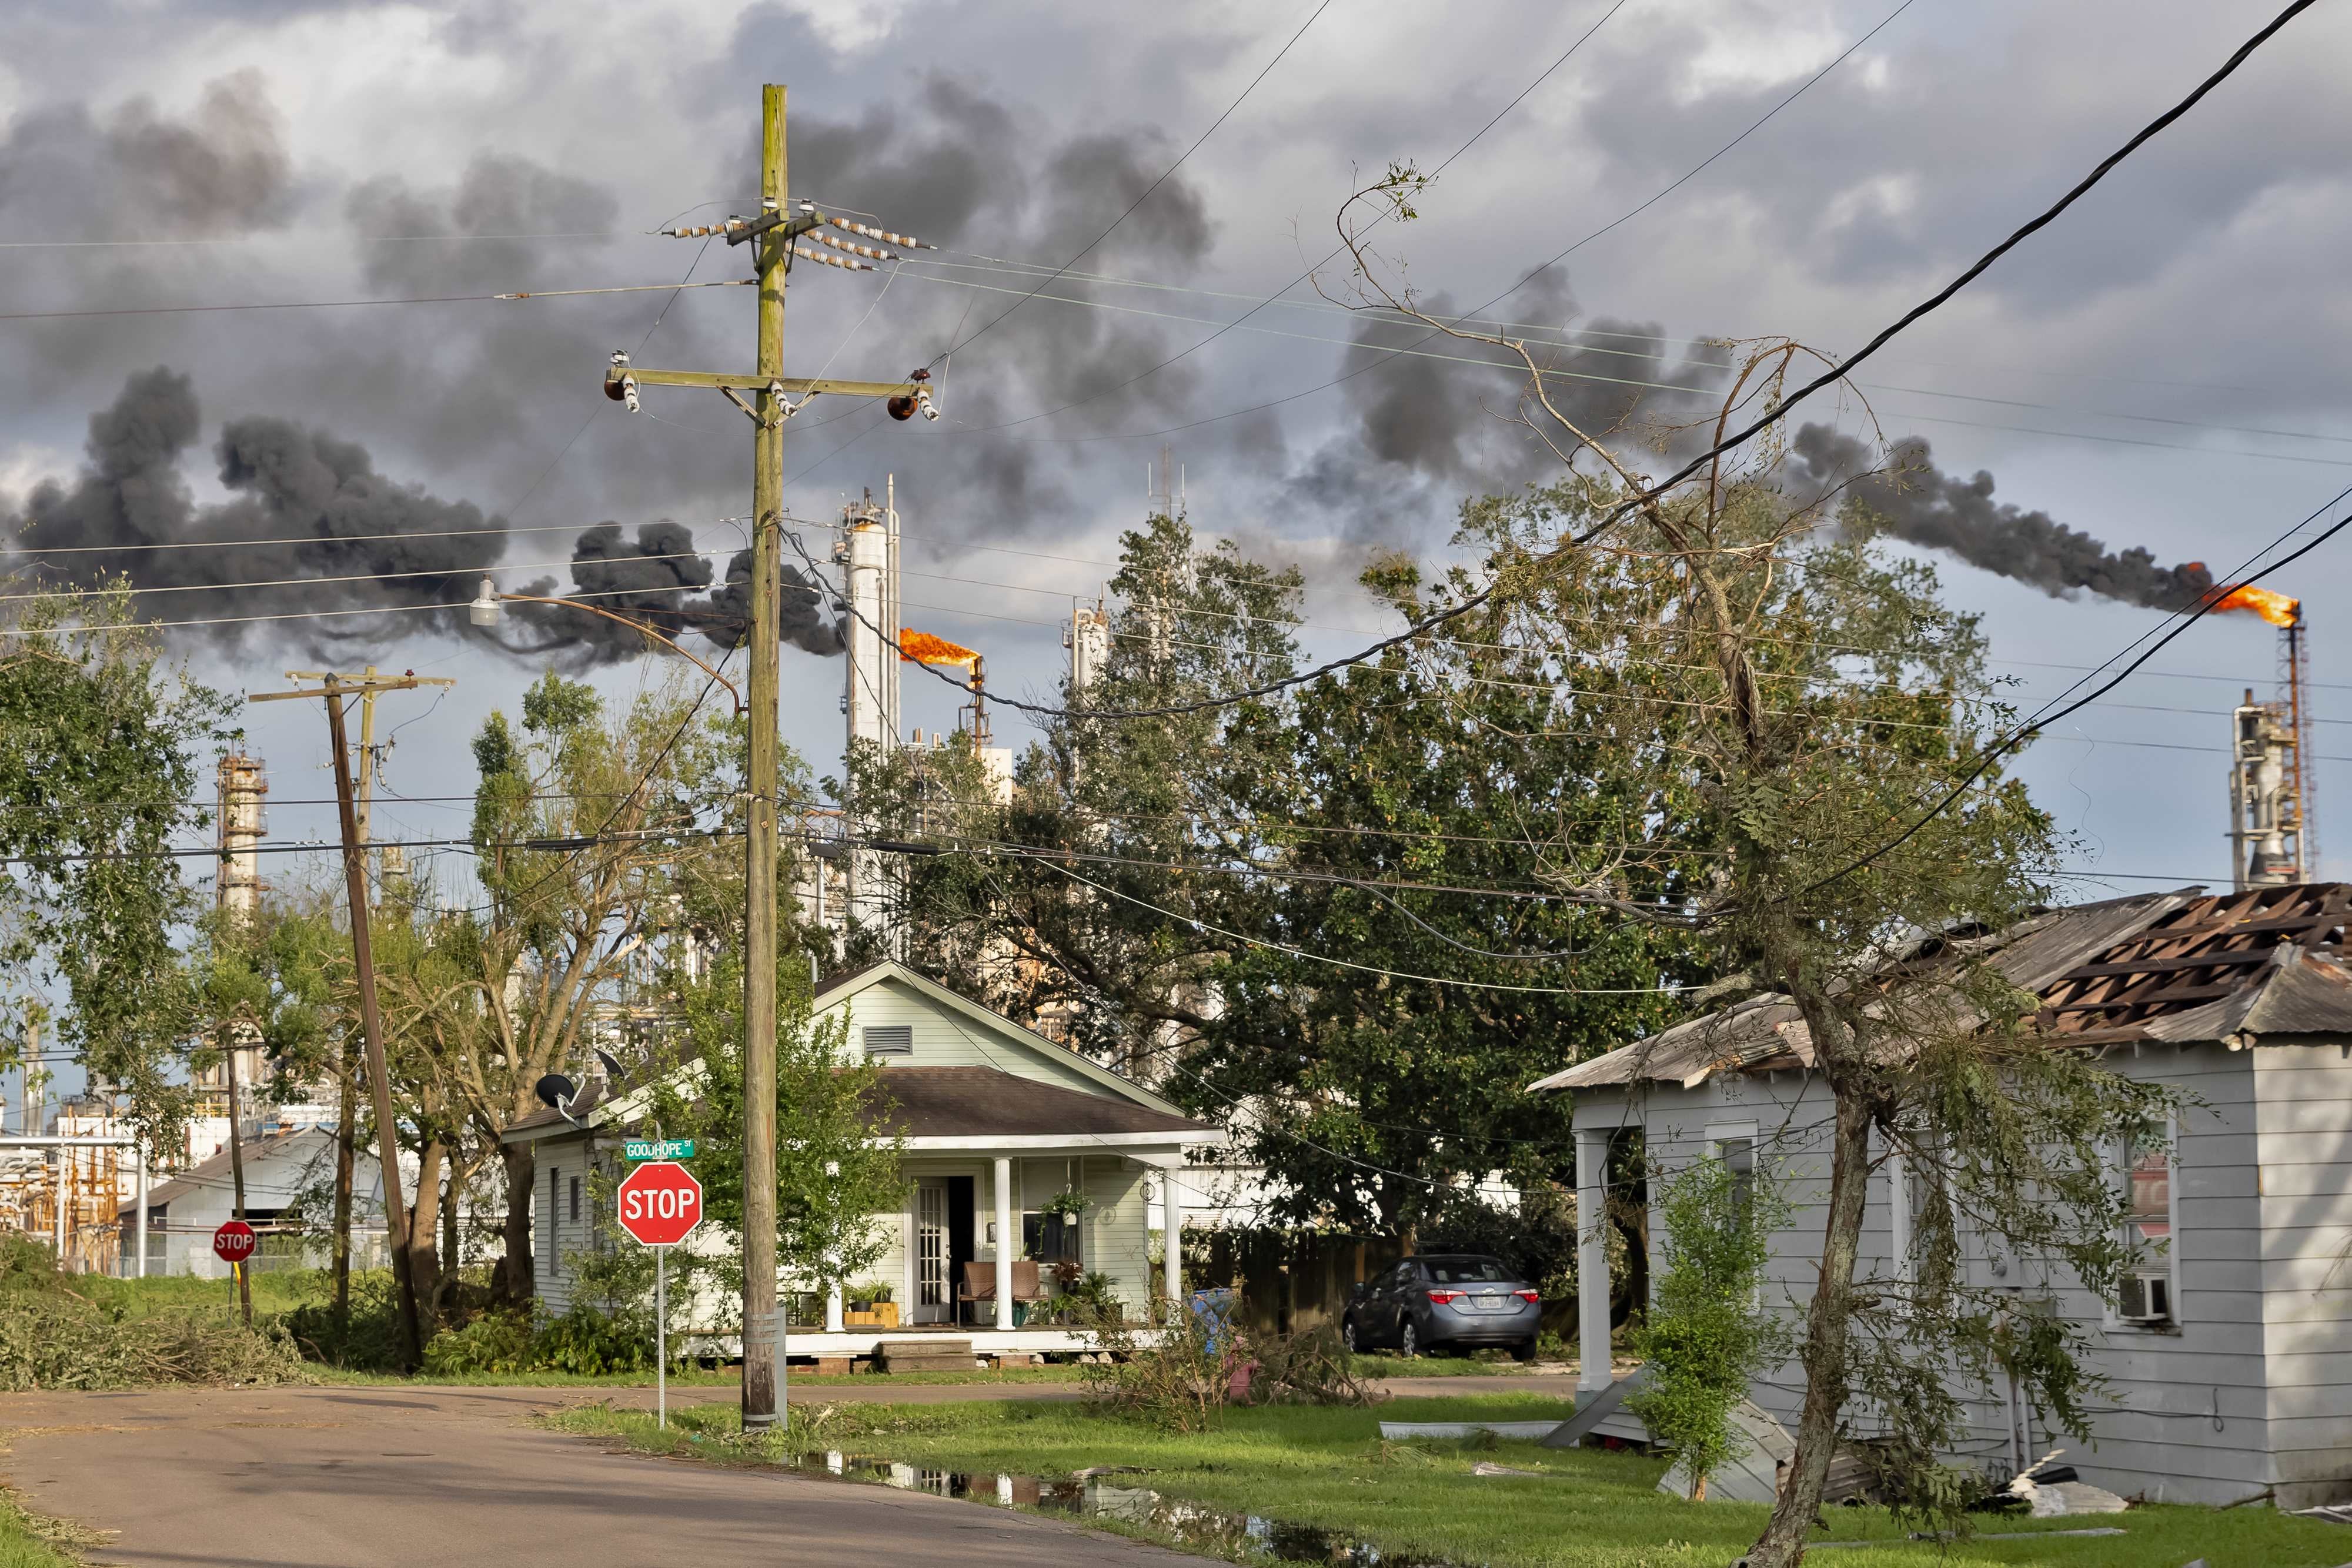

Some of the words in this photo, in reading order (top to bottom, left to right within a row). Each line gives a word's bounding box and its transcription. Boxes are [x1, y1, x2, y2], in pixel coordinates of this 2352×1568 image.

[627, 1143, 683, 1156] GOODHOPE
[625, 1189, 695, 1219] STOP
[216, 1233, 253, 1249] STOP
